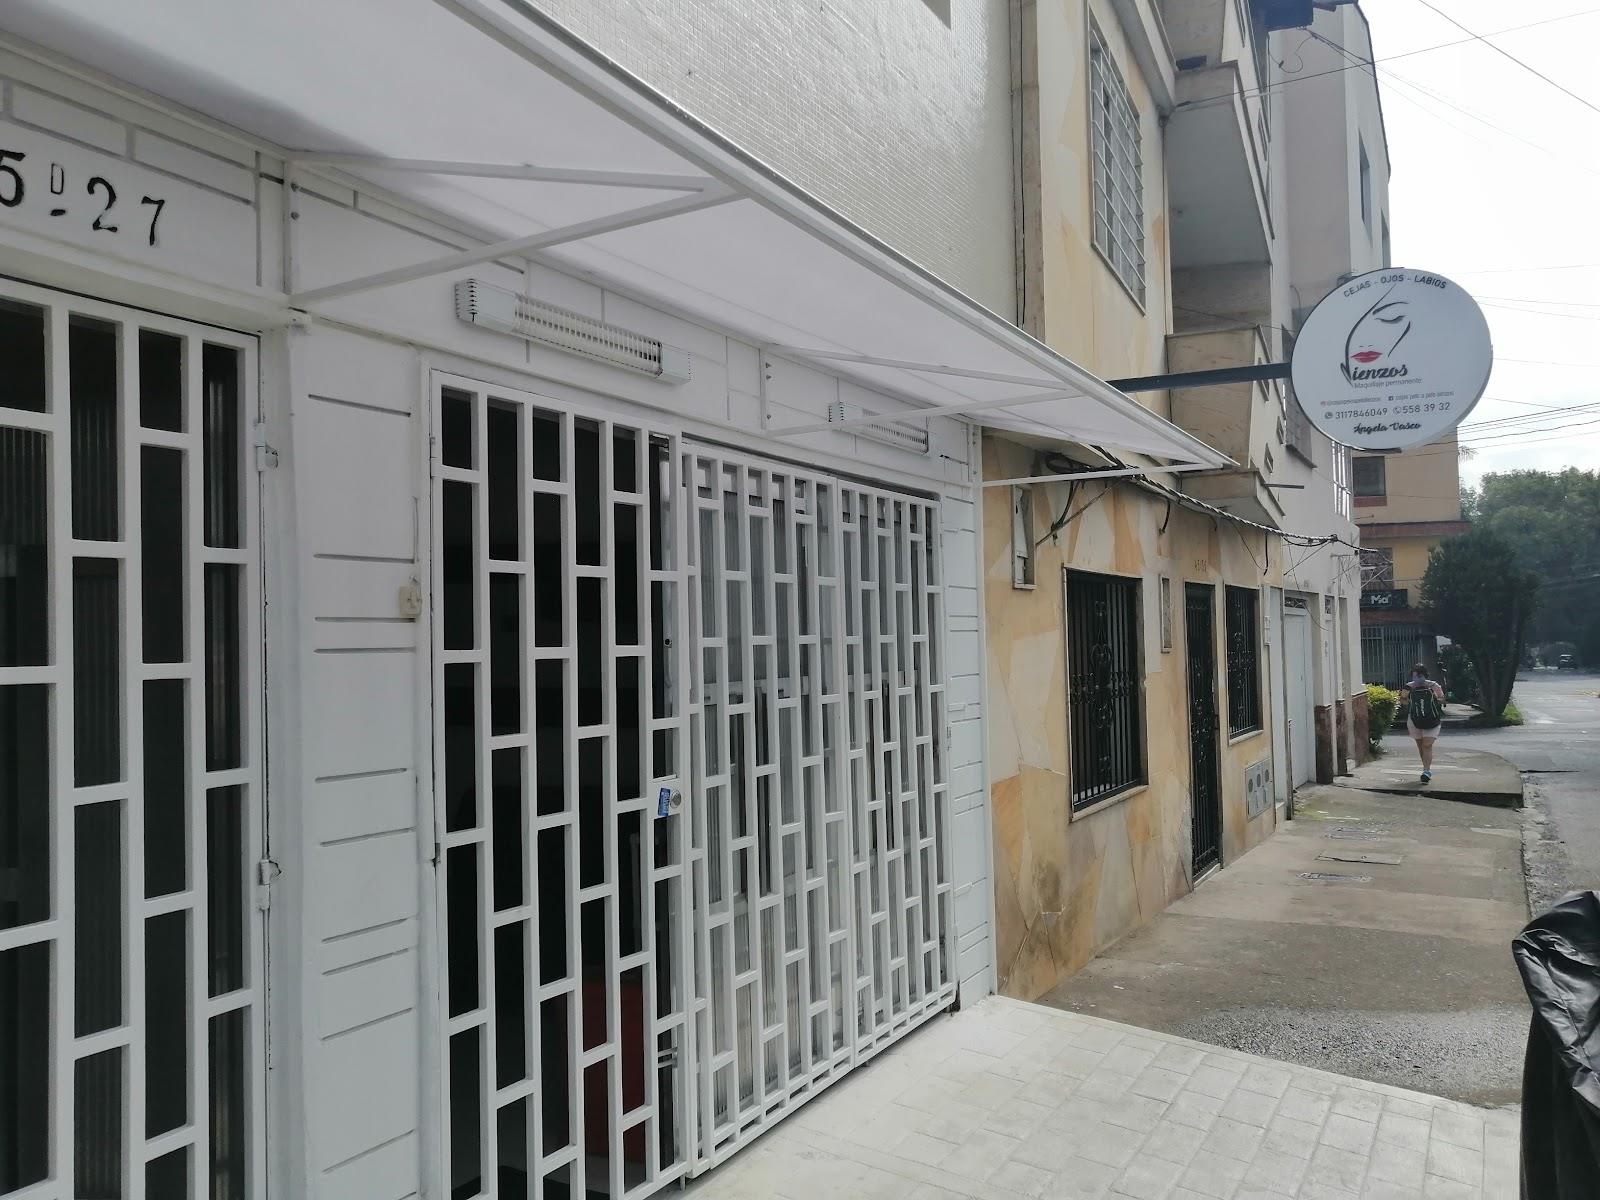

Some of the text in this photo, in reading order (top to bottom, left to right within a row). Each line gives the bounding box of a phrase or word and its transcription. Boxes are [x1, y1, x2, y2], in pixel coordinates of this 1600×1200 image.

[1343, 280, 1371, 298] CEJAS
[1380, 274, 1404, 284] OJOS
[1414, 274, 1447, 289] LABIOS
[1335, 407, 1388, 420] 3117846049
[1403, 402, 1450, 414] 558 39 32
